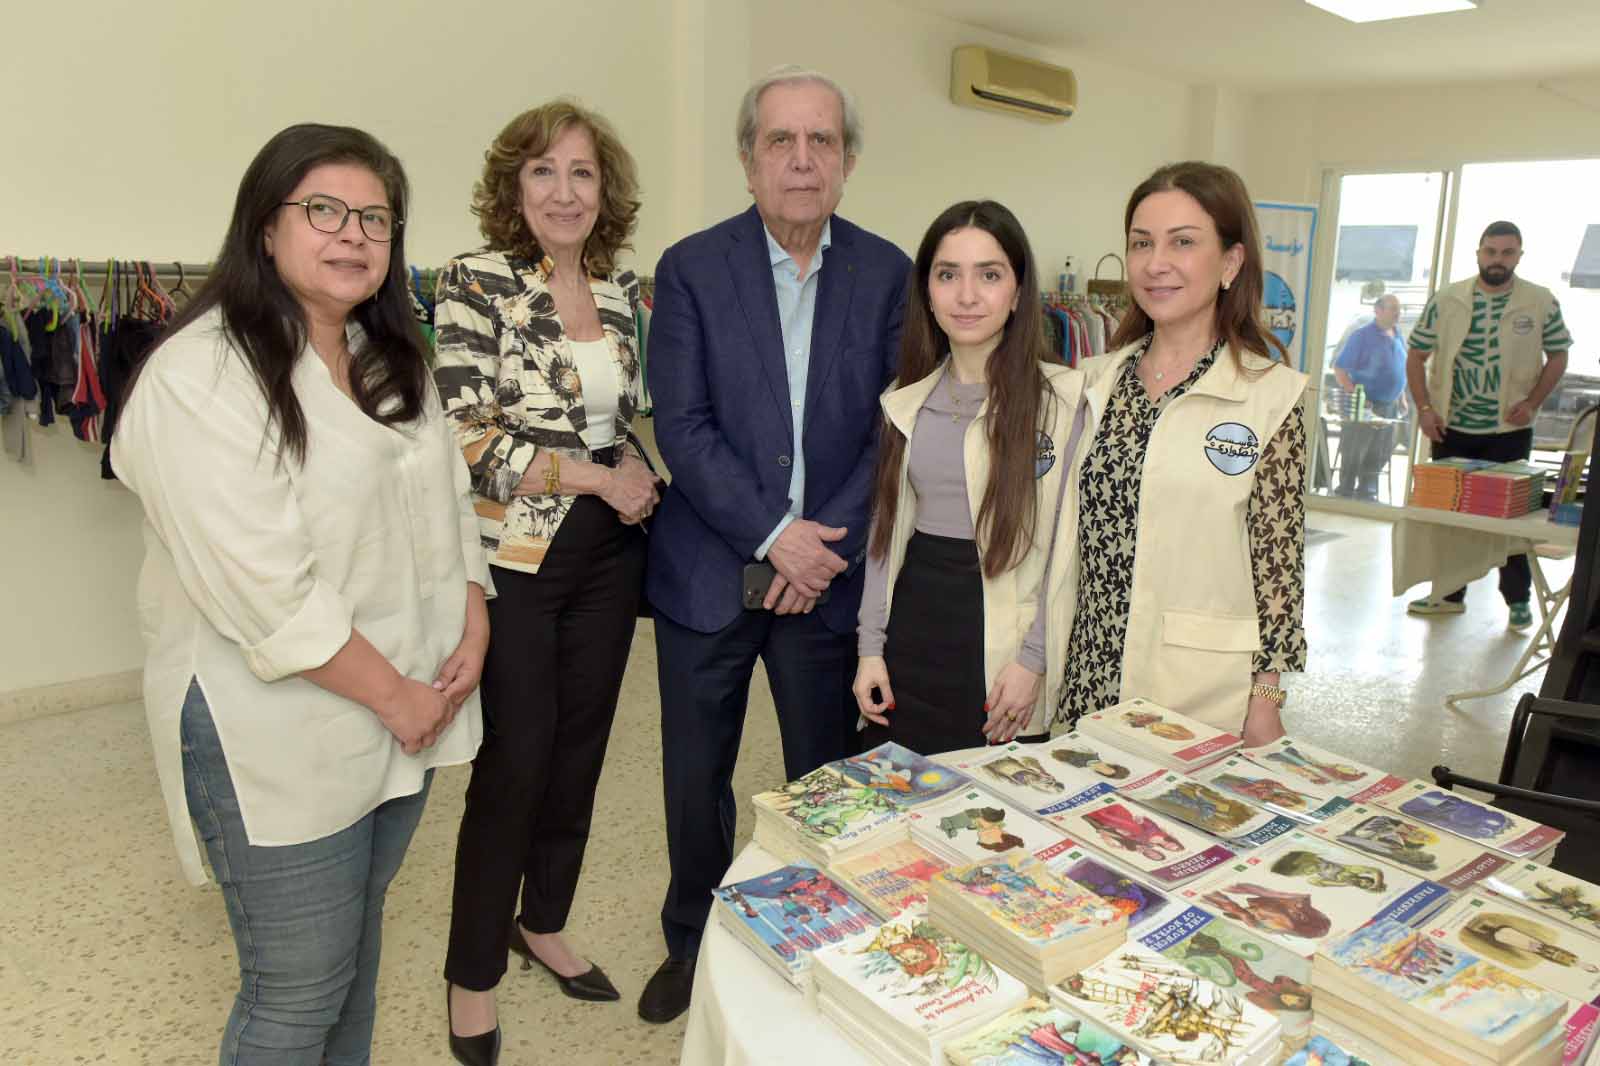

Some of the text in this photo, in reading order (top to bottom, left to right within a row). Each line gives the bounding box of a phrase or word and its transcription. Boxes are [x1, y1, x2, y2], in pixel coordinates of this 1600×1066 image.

[1182, 911, 1196, 922] OF
[1185, 915, 1206, 930] THE
[1152, 920, 1183, 941] NOTRE
